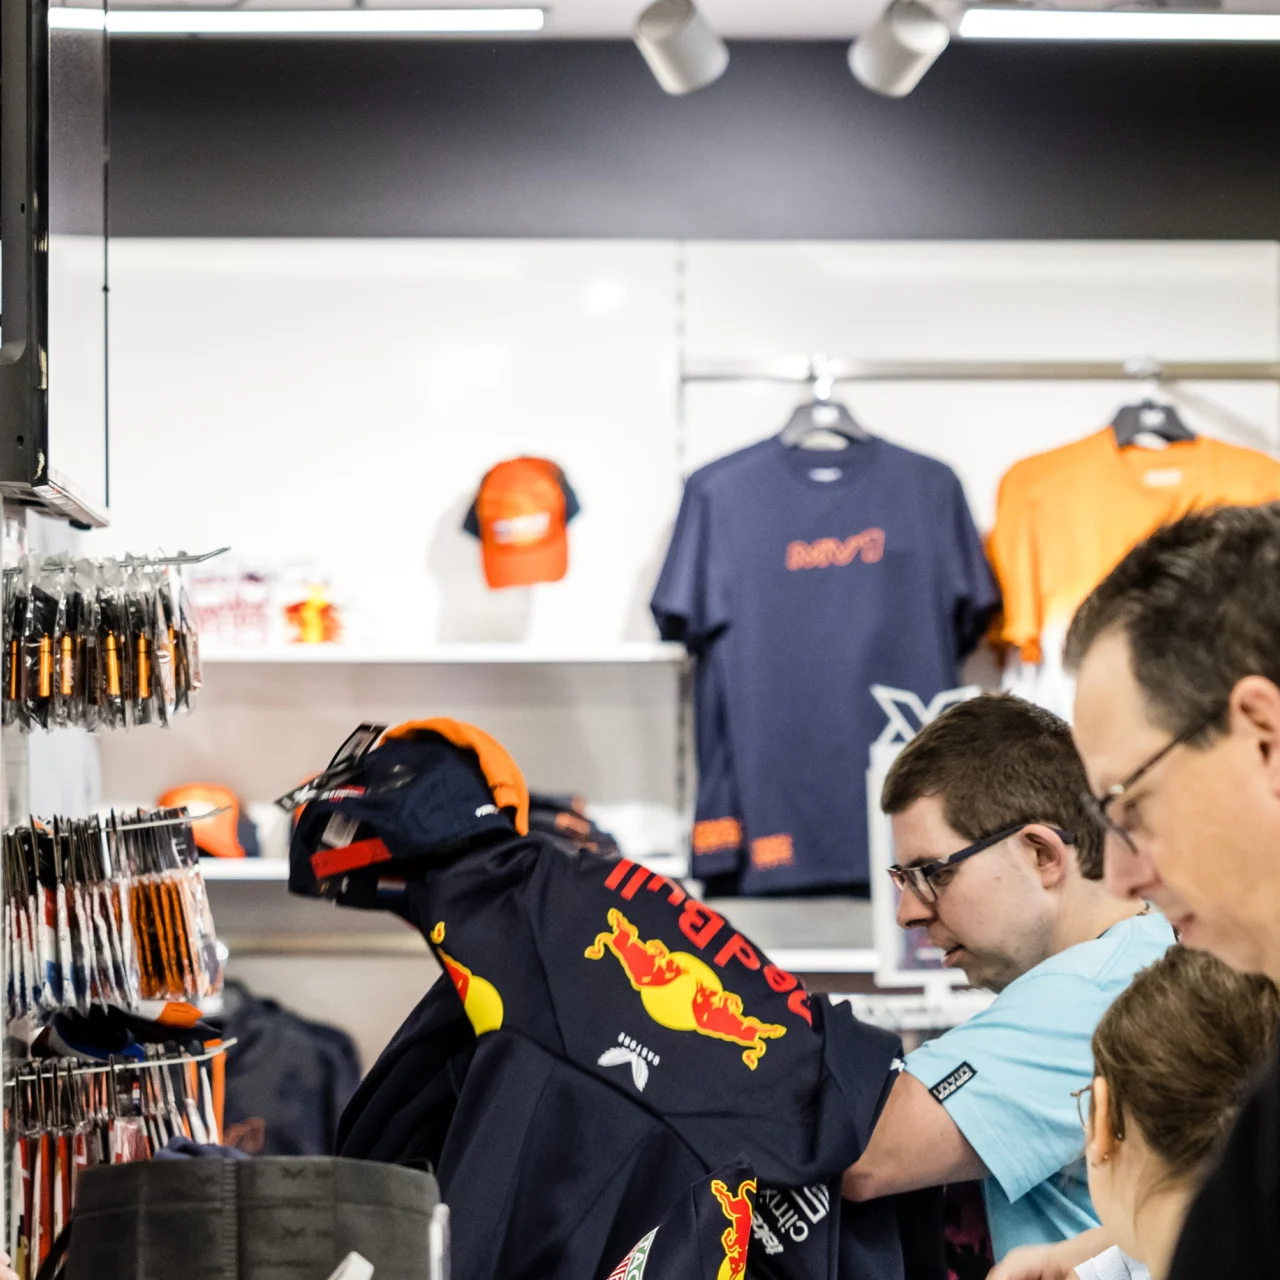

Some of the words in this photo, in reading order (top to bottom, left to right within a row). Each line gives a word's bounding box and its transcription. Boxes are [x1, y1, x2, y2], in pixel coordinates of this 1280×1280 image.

[604, 857, 725, 950] Bull
[713, 932, 813, 1028] Red
[759, 1187, 809, 1242] citrix
